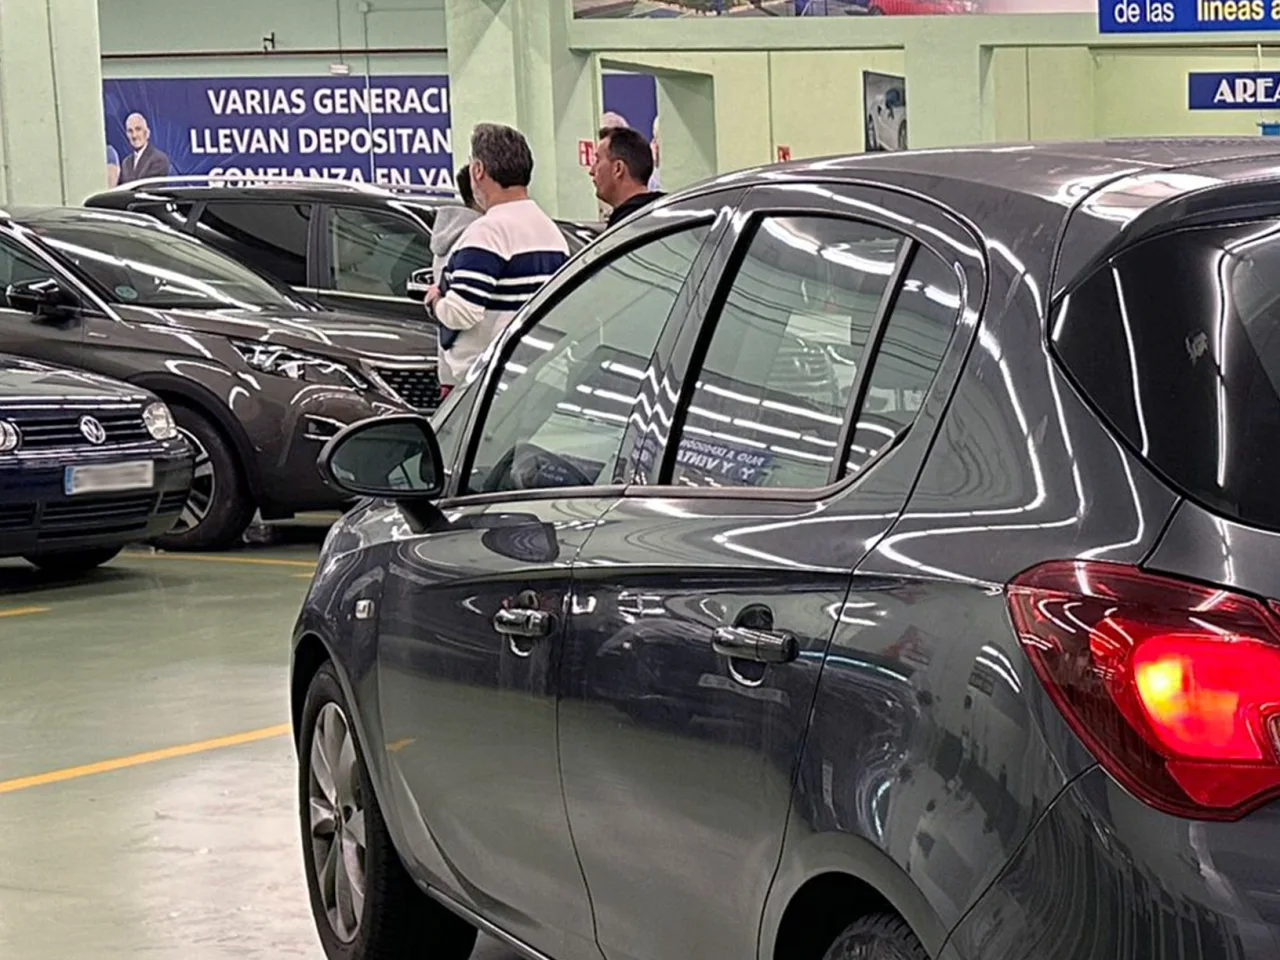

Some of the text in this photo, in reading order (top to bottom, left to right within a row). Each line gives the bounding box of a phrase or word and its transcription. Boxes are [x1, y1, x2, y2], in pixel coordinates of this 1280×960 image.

[1114, 0, 1140, 23] de
[1146, 0, 1175, 22] las
[207, 87, 449, 115] VARIAS GENERACI
[190, 127, 452, 154] LLEVAN DEPOSITAN
